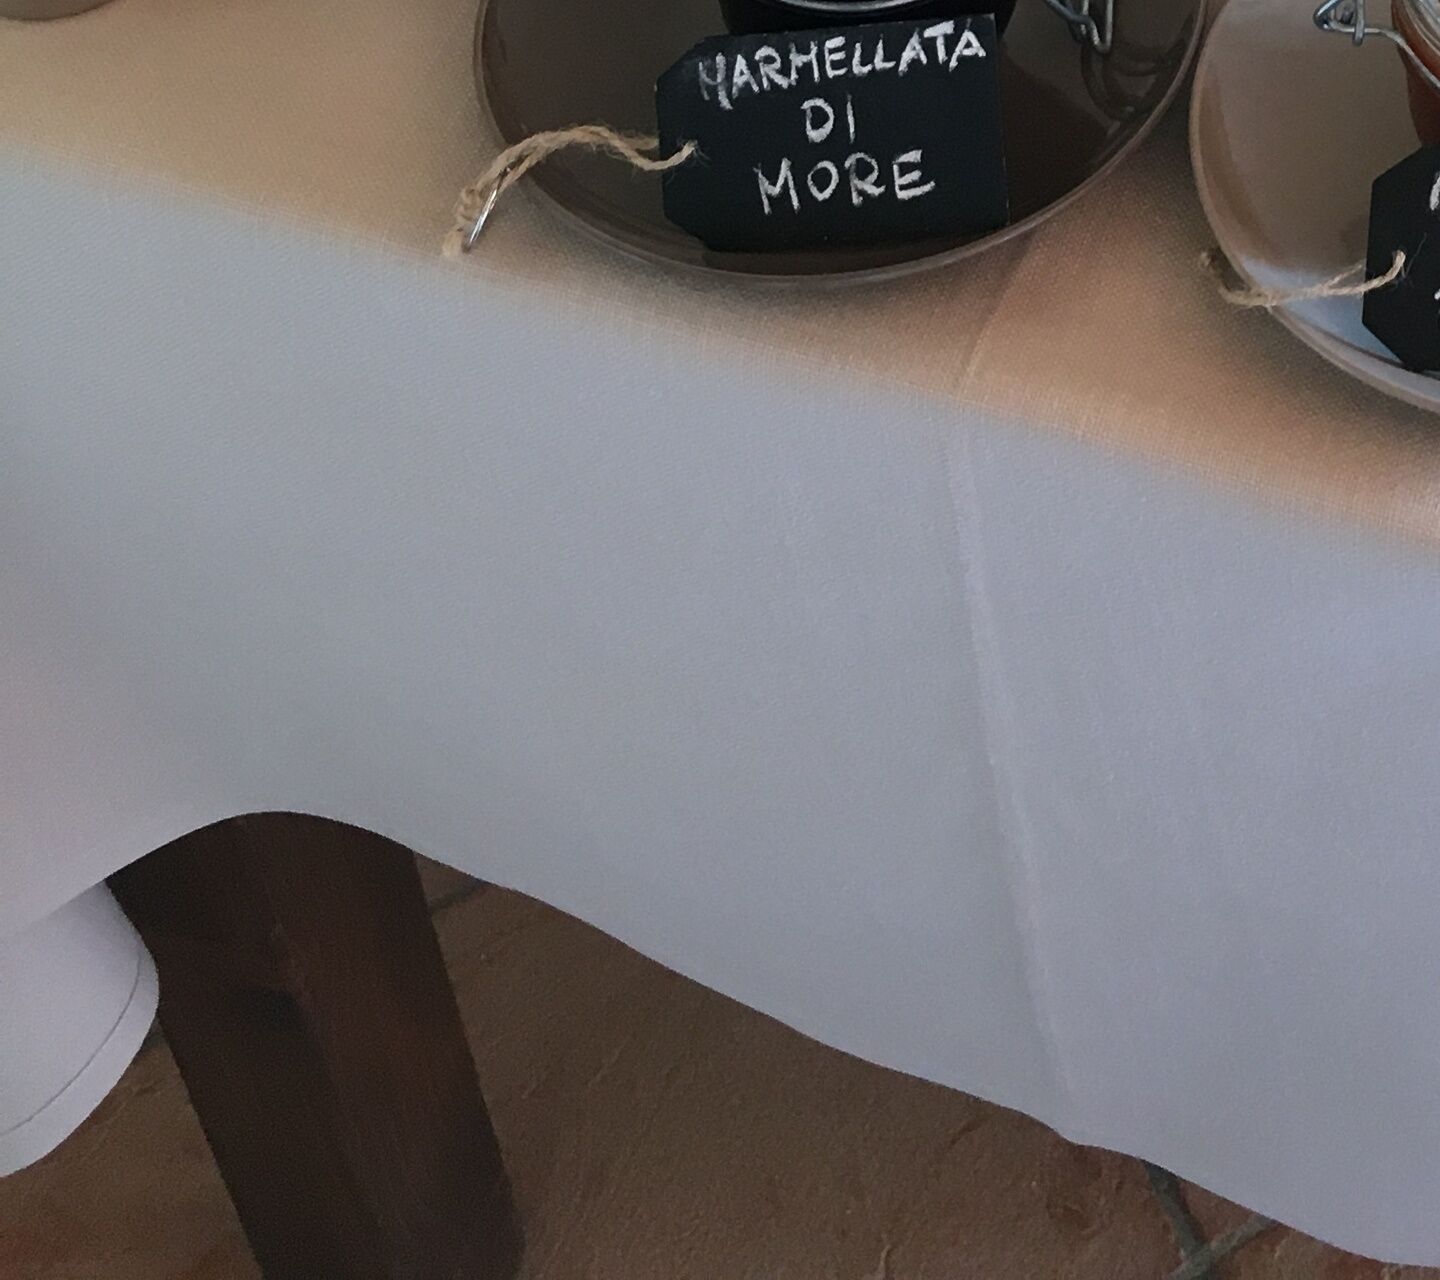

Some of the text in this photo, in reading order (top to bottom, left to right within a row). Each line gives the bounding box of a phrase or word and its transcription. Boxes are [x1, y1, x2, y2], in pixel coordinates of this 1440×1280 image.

[698, 20, 987, 110] MARMELLATA
[801, 95, 856, 144] DI
[754, 149, 936, 215] MORE
